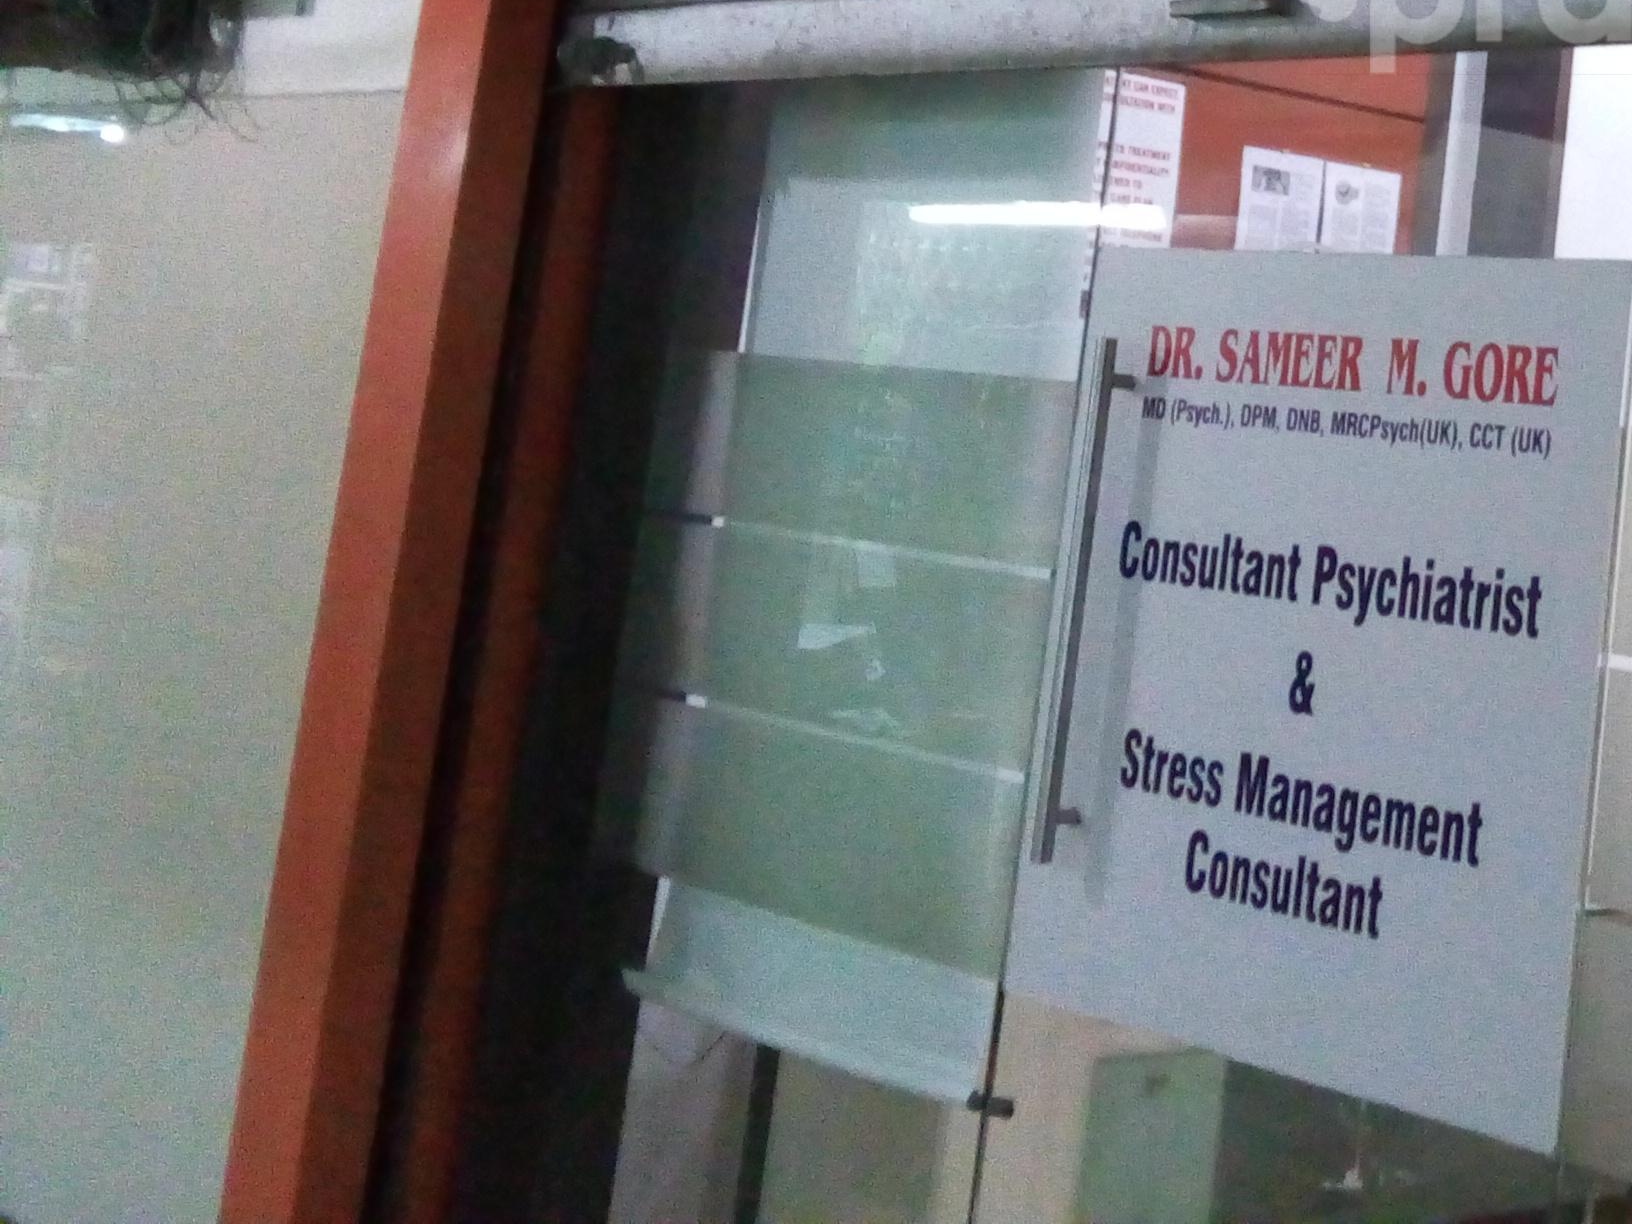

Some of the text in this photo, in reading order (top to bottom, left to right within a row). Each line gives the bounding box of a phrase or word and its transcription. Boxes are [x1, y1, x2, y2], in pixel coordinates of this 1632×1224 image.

[1148, 325, 1560, 408] DR. SAMEER M. GORE
[1142, 395, 1166, 420] MD
[1240, 403, 1280, 433] DPM,
[1286, 407, 1325, 438] DNB,
[1330, 411, 1463, 452] MRCPsych(UK),
[1470, 422, 1507, 451] CCT
[1511, 425, 1552, 461] (UK)
[1119, 520, 1543, 638] Consultant Psychiatrist
[1289, 651, 1315, 716] &
[1120, 728, 1483, 867] Stress Management
[1185, 829, 1383, 939] Consultant
